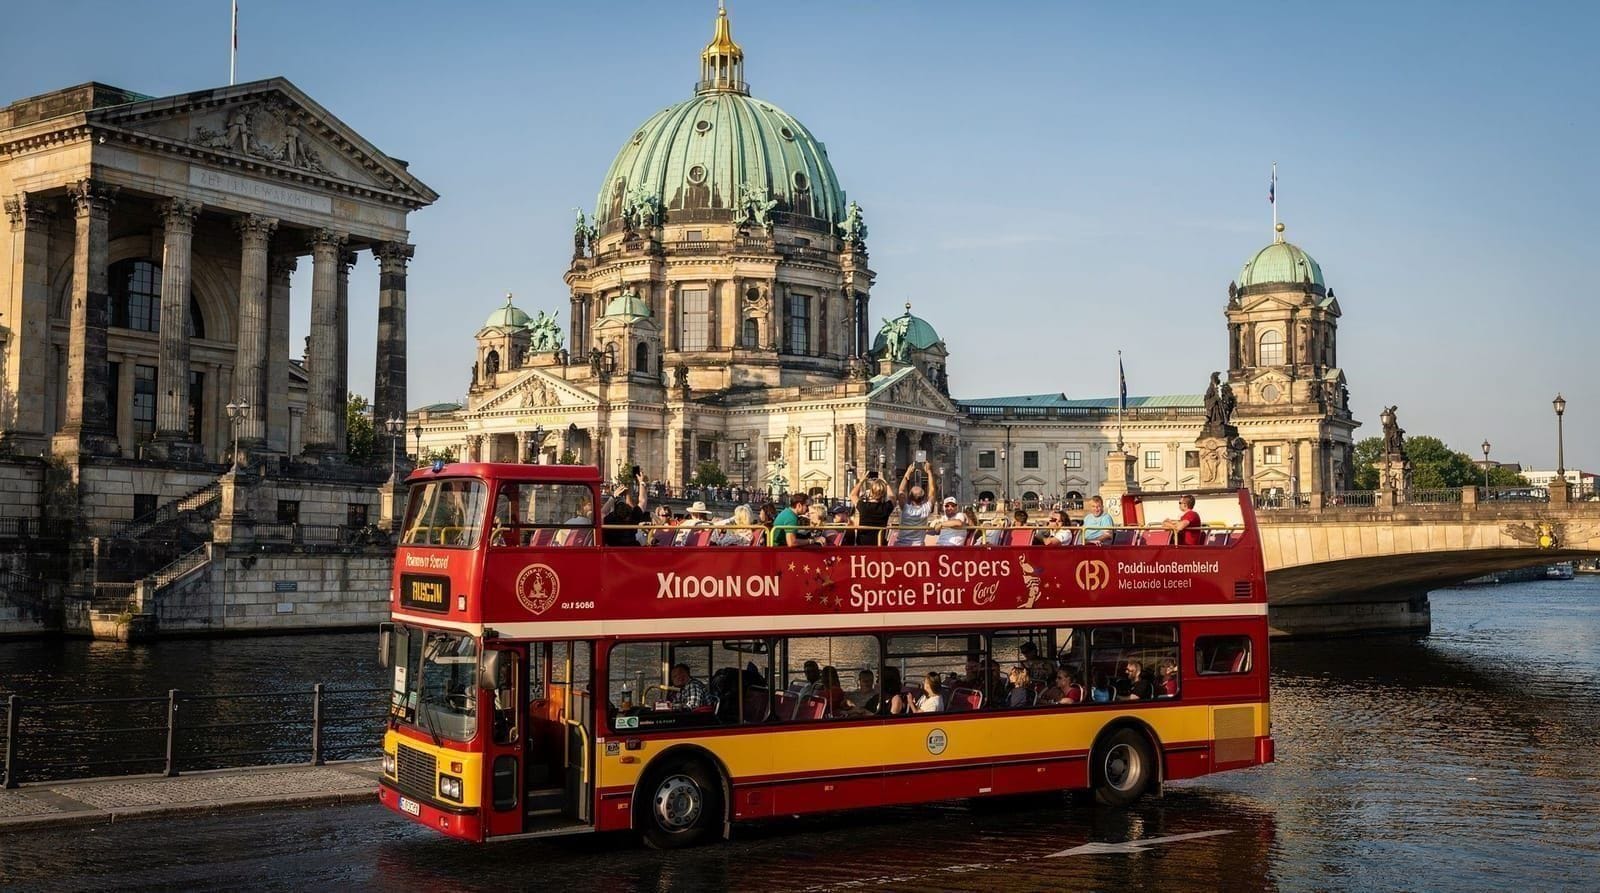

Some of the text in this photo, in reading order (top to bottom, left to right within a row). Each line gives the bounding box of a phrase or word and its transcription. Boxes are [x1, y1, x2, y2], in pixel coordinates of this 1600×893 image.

[850, 554, 1010, 584] Hop-on Scpers
[746, 575, 779, 597] ON
[850, 582, 965, 612] Sprcie Piar
